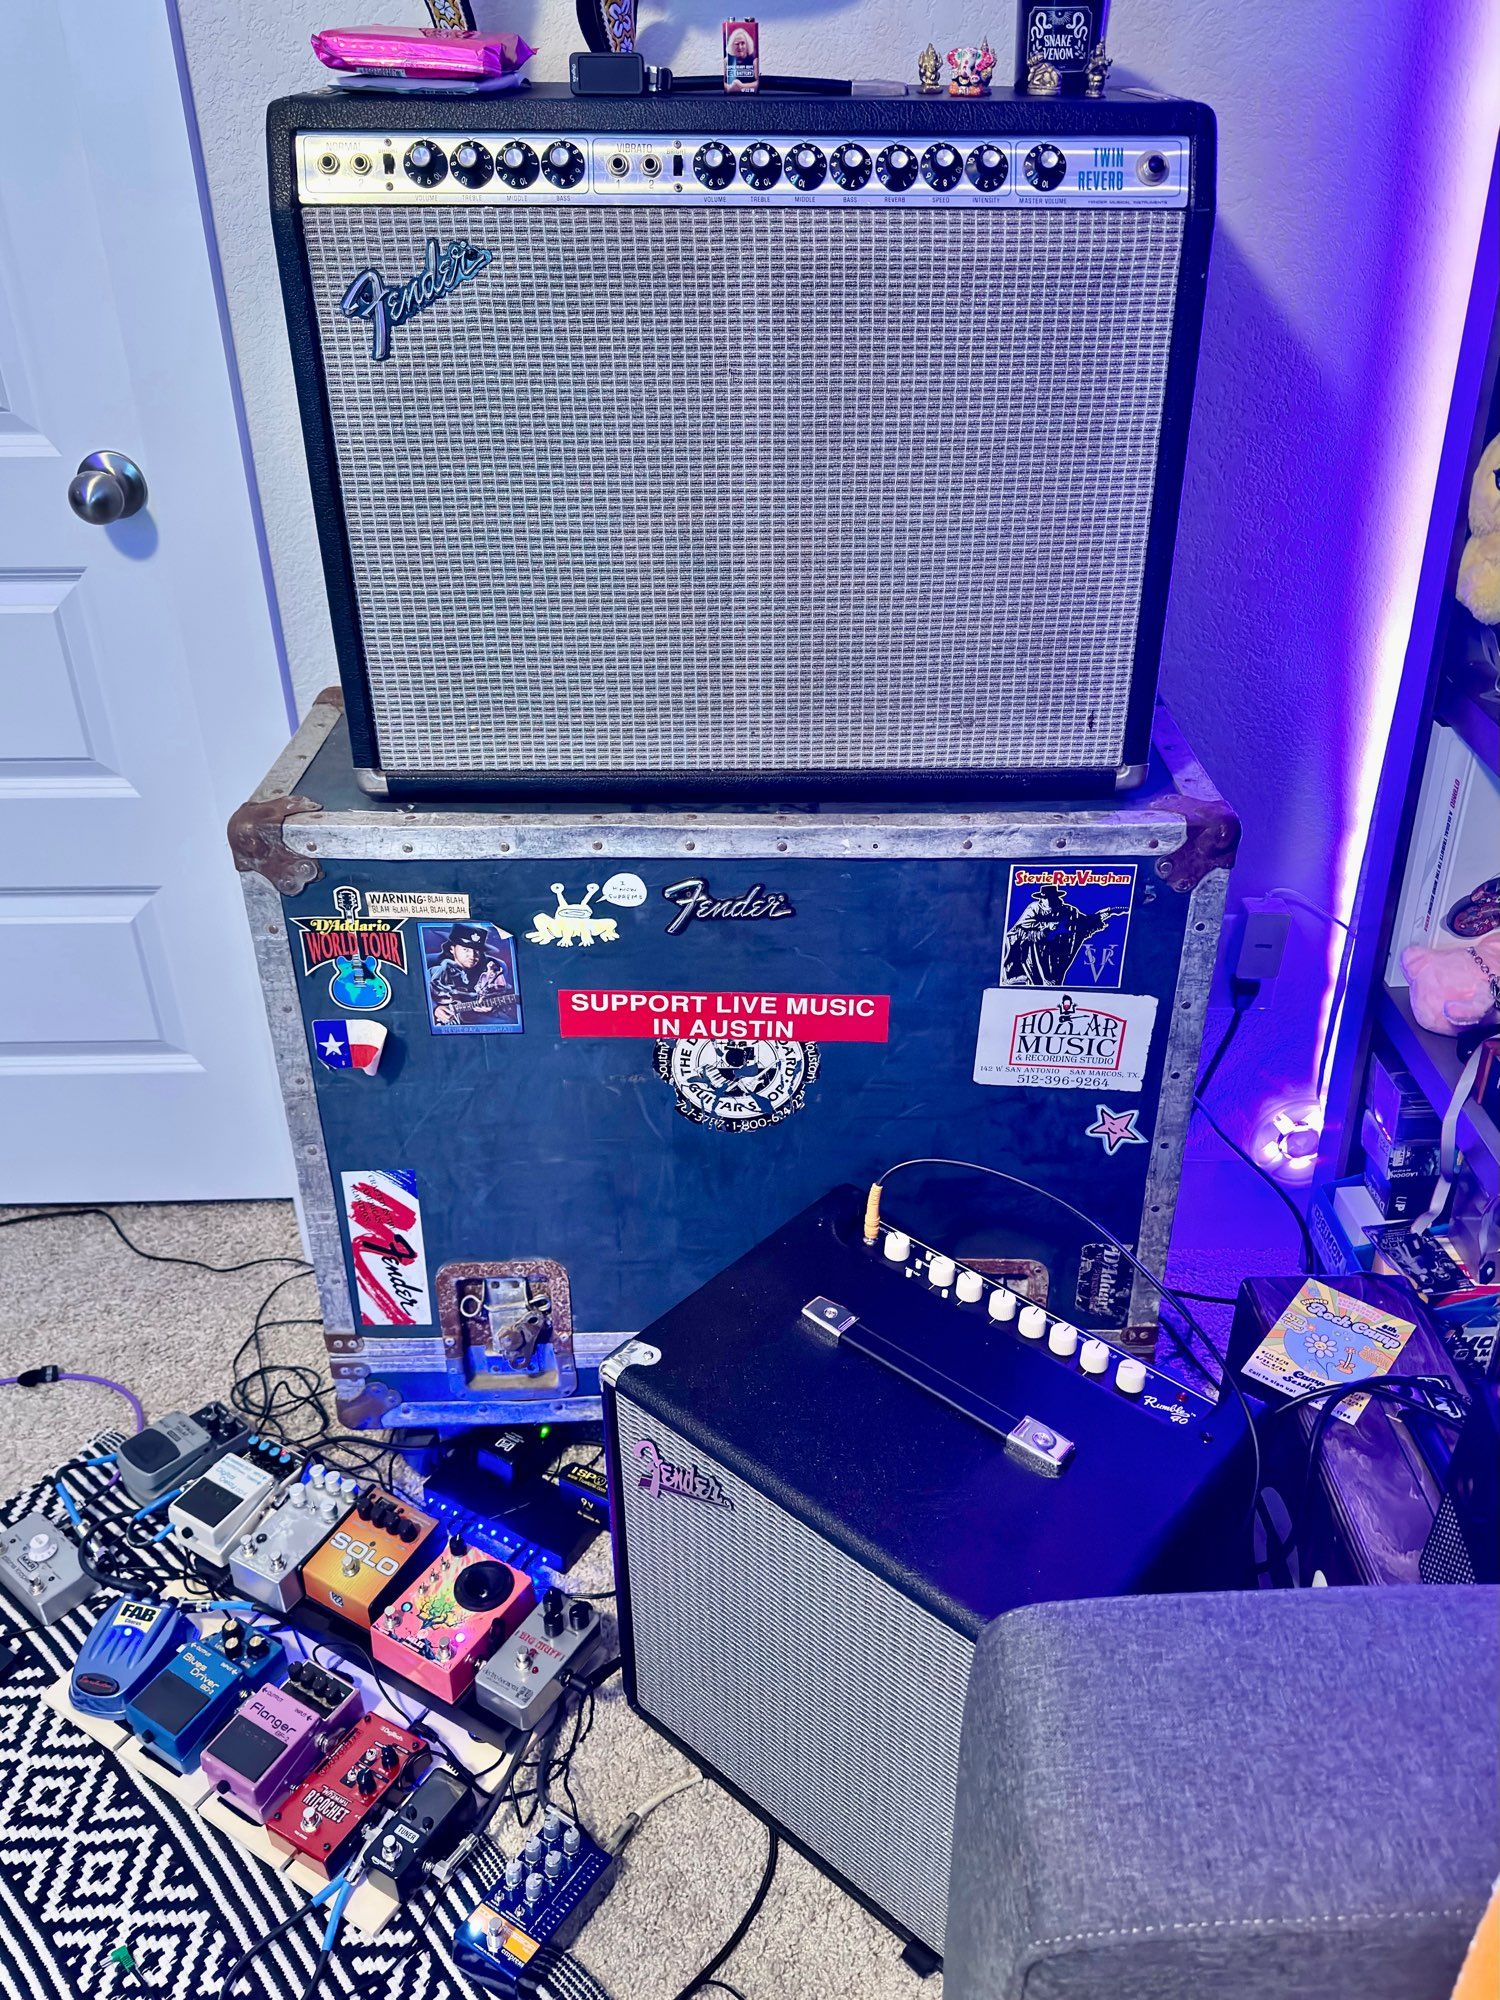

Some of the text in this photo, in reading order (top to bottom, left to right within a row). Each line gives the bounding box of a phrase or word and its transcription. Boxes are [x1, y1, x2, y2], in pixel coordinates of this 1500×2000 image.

[1043, 34, 1074, 47] SNAKE
[1043, 47, 1074, 60] VENOM
[616, 142, 653, 154] VIBRATO
[1093, 147, 1124, 168] TWIN
[1078, 170, 1124, 191] REVERB
[340, 237, 493, 361] Fender
[369, 893, 427, 905] WARNING:
[663, 877, 795, 934] Fender
[310, 919, 391, 935] D'Addario
[305, 932, 401, 965] WORLD TOUR
[571, 993, 875, 1018] SUPPORT LIVE MUSIC
[653, 1018, 795, 1039] IN AUSTIN
[1021, 1010, 1118, 1038] HOLLAR
[1016, 1035, 1118, 1058] MUSIC
[680, 1048, 692, 1077] THE
[1025, 1053, 1078, 1064] RECORDING
[1079, 1056, 1114, 1065] STUDIO
[1016, 1074, 1110, 1088] 512-396-9264
[1023, 1067, 1060, 1075] ANTONIO
[362, 1233, 424, 1317] Fender
[1306, 1302, 1351, 1329] Rock
[1351, 1321, 1402, 1350] Camp
[1292, 1370, 1326, 1388] Camp
[1143, 1395, 1191, 1419] Rumble
[1169, 1415, 1189, 1425] 40
[632, 1439, 735, 1512] Fender
[329, 1531, 400, 1577] SOLO
[120, 1603, 157, 1622] FAB
[182, 1652, 208, 1672] Blues
[189, 1667, 220, 1688] Driver
[249, 1702, 297, 1733] Flanger
[302, 1789, 352, 1824] RICOCHET
[397, 1826, 417, 1841] TUNER
